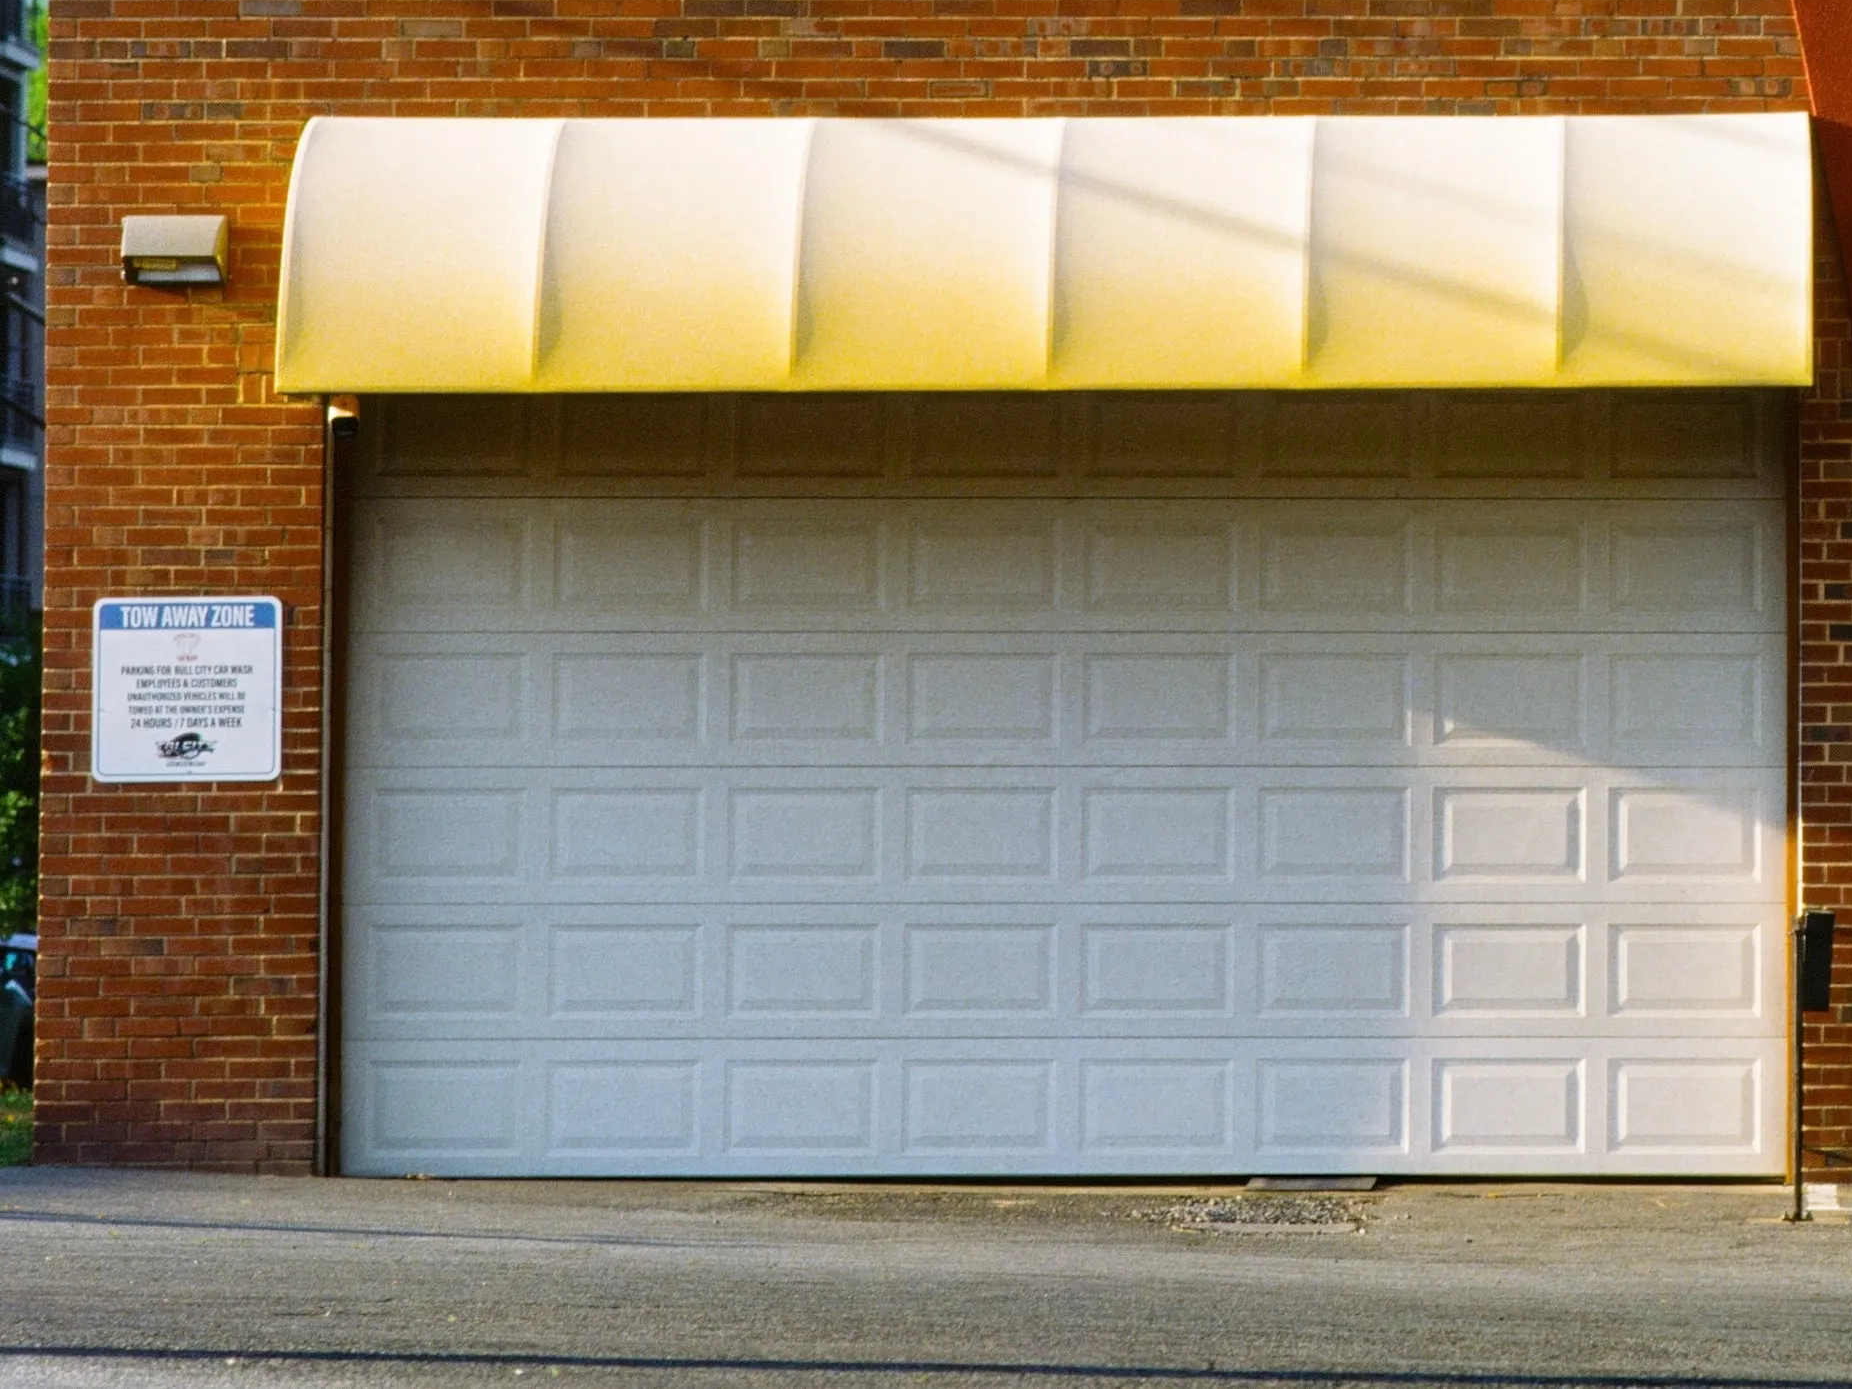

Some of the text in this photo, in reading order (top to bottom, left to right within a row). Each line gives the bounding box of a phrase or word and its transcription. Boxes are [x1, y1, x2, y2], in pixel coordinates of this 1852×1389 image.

[120, 605, 256, 628] TOW AWAY ZONE
[120, 665, 254, 675] PARKING FOR BULL CITY CAR WASH
[136, 678, 182, 689] EMPLOYEES
[190, 678, 238, 688] CUSTOMERS
[127, 691, 246, 701] UNAUTHORIZED VEHICLES WILL BE
[128, 705, 245, 714] TOWED AT THE OWNER'S EXPENSE
[130, 718, 141, 729] 24
[143, 718, 172, 728] HOURS
[186, 718, 209, 728] DAYS
[210, 718, 216, 728] A
[218, 717, 243, 728] WEEK
